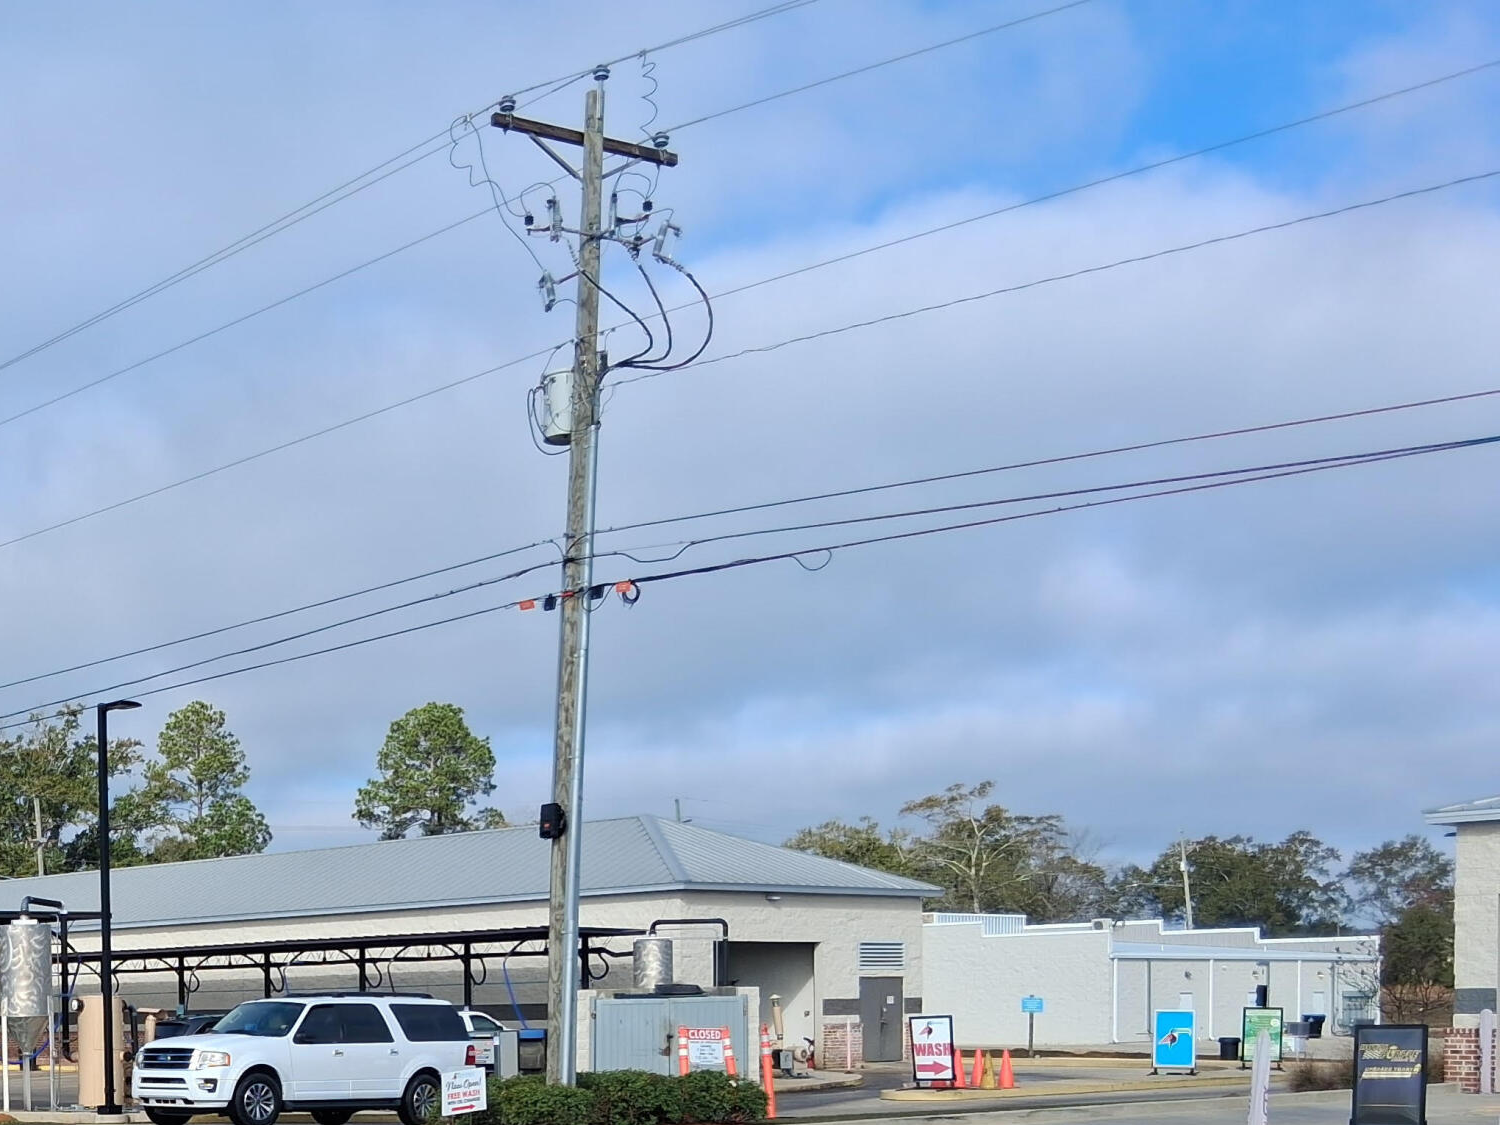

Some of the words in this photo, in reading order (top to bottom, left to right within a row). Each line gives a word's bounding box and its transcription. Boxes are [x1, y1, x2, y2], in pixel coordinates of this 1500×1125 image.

[688, 1029, 721, 1040] CLOSED
[914, 1043, 951, 1057] WASH
[447, 1092, 461, 1100] FREE
[462, 1090, 481, 1098] WASH
